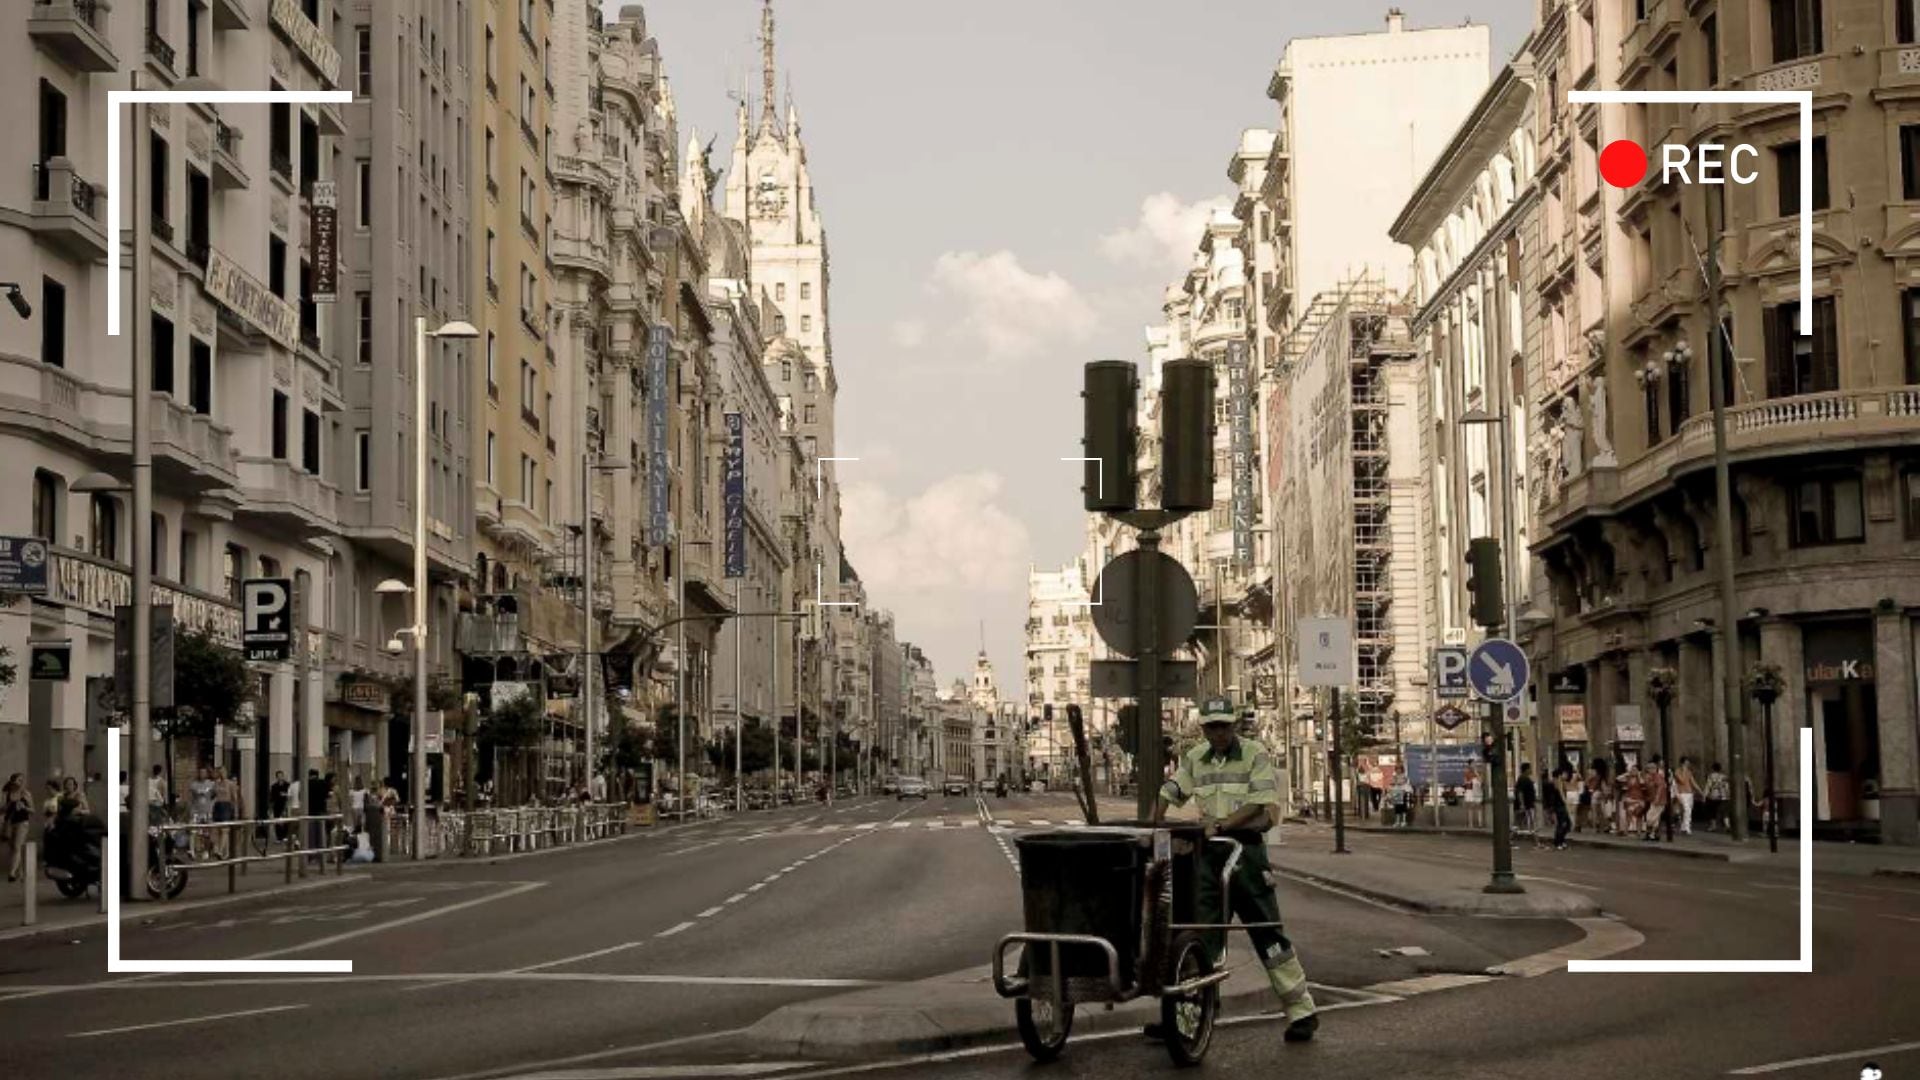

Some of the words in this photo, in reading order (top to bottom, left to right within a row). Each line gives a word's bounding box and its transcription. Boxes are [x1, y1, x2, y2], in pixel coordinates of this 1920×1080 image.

[651, 327, 665, 402] HOTEL
[1230, 367, 1246, 444] HOTEL
[1233, 452, 1249, 561] REGENTE
[245, 583, 287, 631] P
[1438, 651, 1466, 686] P
